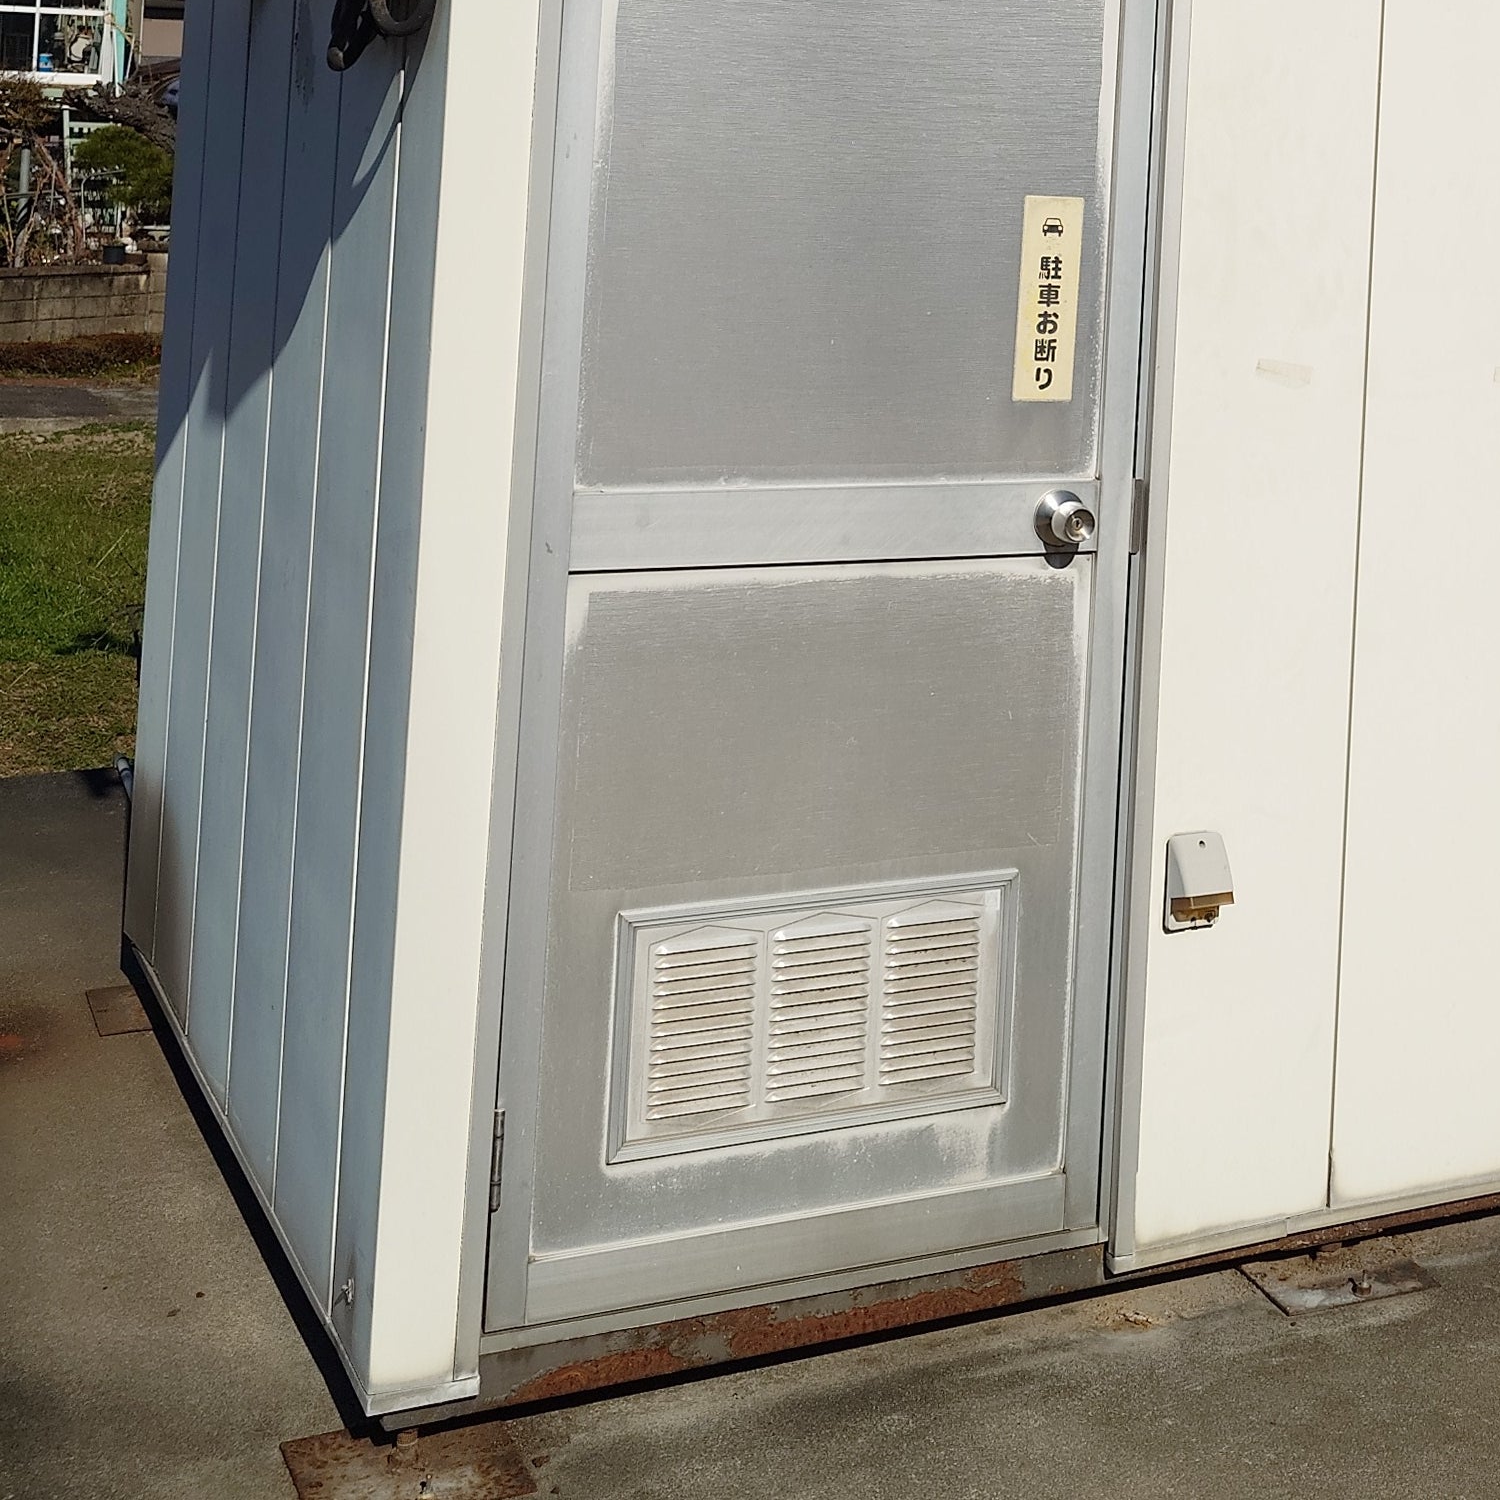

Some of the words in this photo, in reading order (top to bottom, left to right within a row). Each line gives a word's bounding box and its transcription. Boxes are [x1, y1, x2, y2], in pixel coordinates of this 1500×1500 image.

[1033, 255, 1063, 391] 駐車お断り
